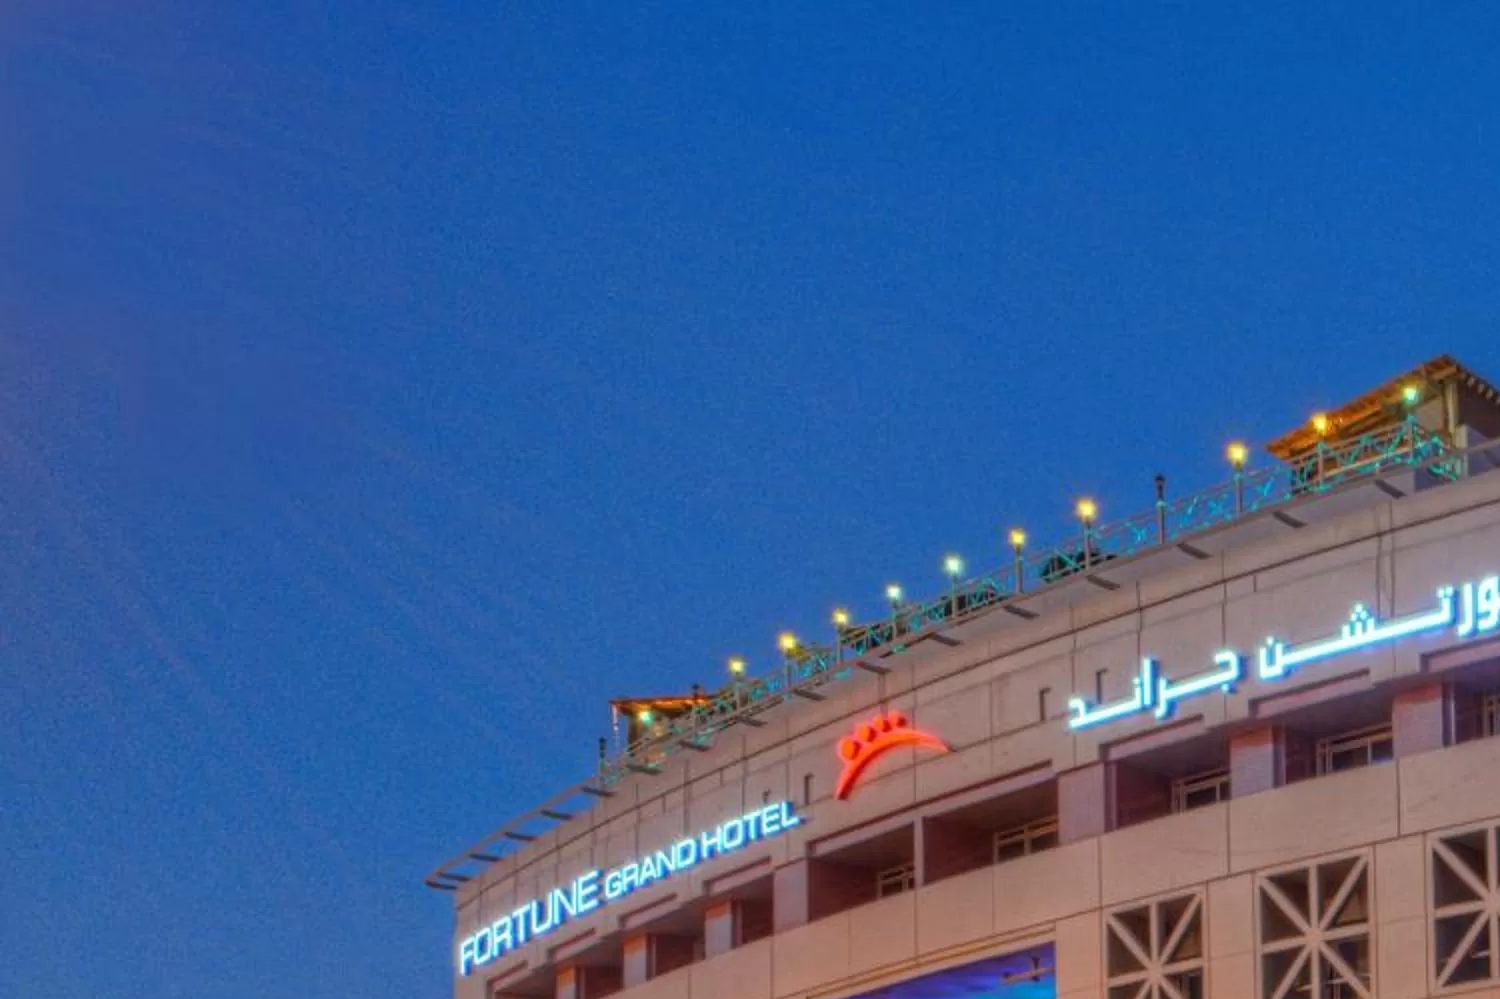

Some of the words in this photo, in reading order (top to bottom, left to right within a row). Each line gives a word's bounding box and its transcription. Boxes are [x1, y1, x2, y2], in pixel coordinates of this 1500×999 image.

[1067, 651, 1242, 731] جراند
[459, 871, 600, 976] FORTUNE
[604, 840, 697, 901] GRAND
[701, 800, 801, 858] HOTEL
